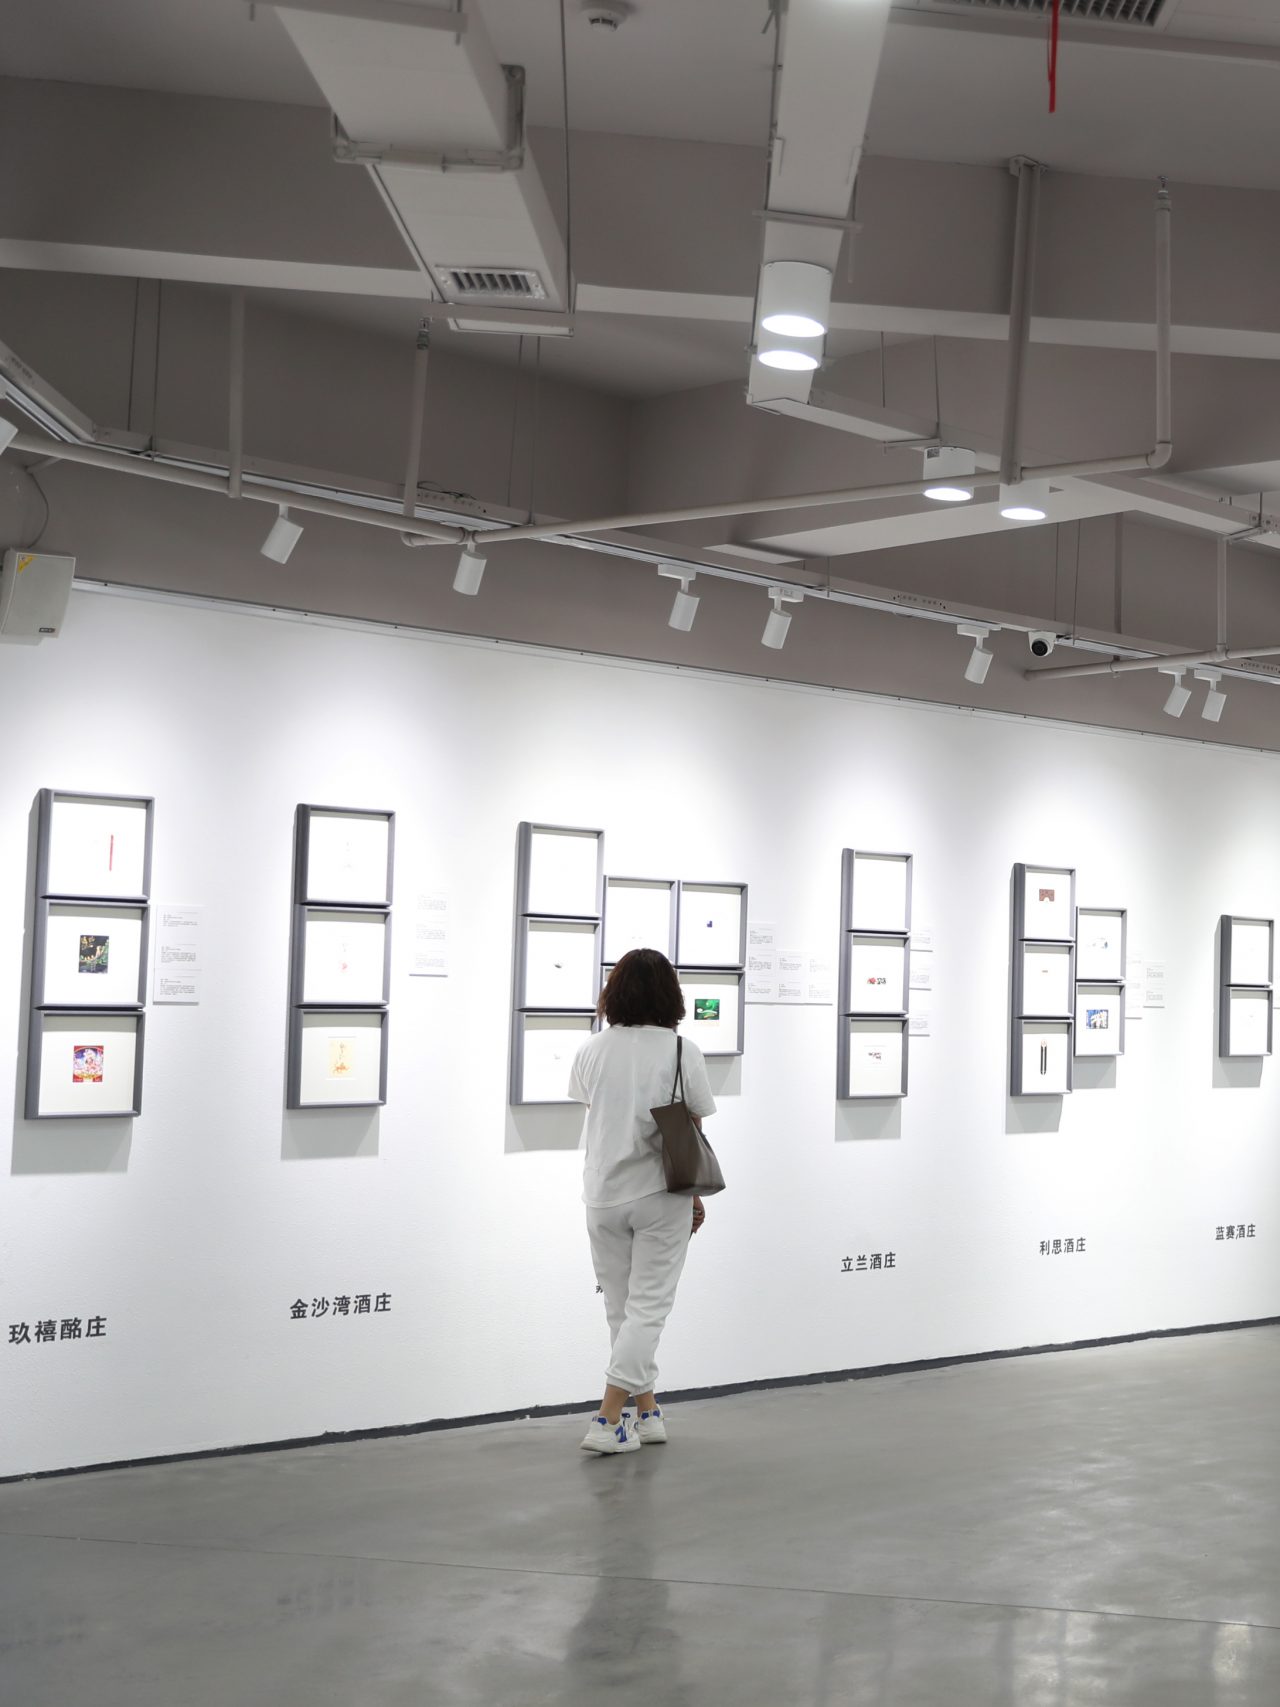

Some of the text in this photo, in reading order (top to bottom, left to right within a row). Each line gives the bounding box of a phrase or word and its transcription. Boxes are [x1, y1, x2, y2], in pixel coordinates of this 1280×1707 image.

[1214, 1223, 1257, 1241] 蓝赛酒庄
[1039, 1236, 1087, 1256] 利思酒庄
[840, 1251, 897, 1273] 立兰酒庄
[289, 1291, 392, 1320] 金沙湾酒庄
[7, 1315, 108, 1346] 玖禧酩庄
